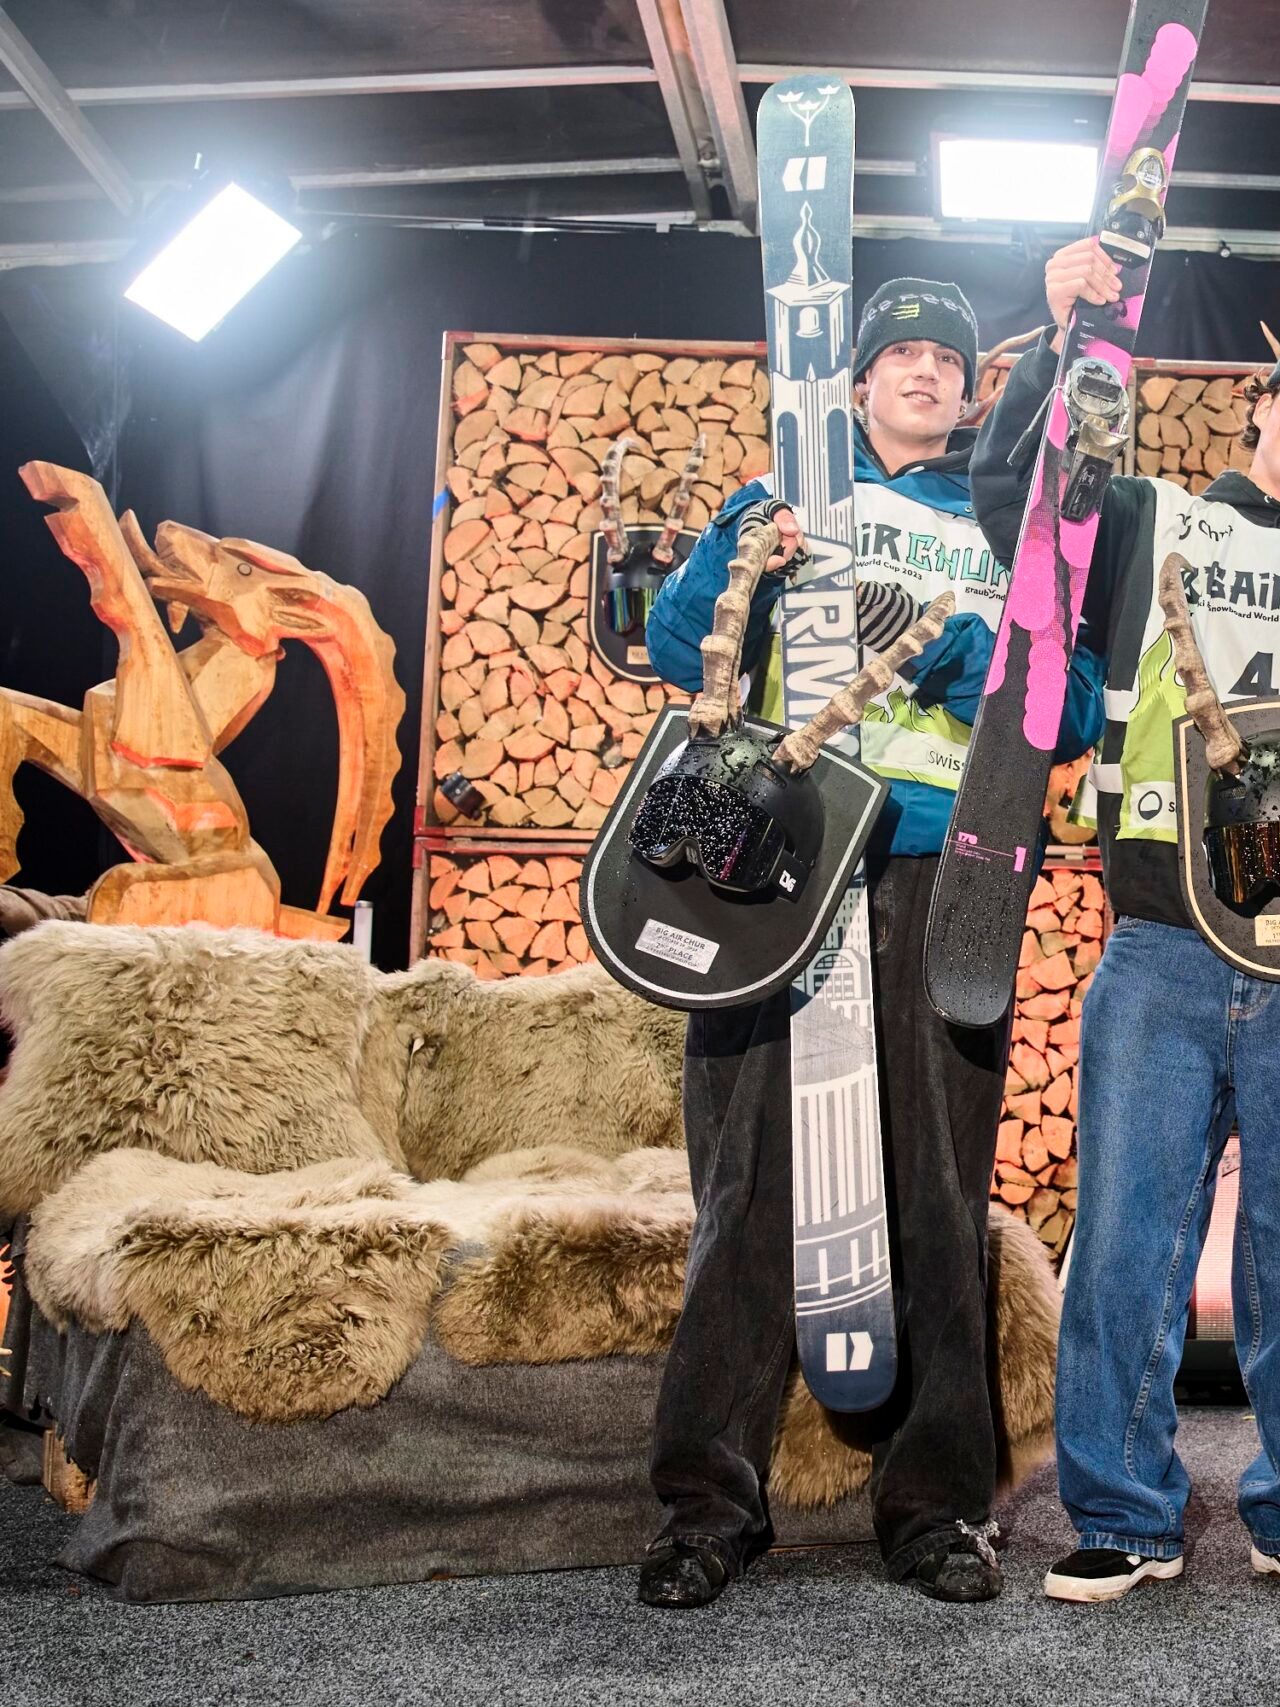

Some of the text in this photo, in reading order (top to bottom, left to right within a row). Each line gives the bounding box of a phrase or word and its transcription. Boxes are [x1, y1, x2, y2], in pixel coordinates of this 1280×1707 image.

[856, 559, 923, 580] World Cup 2023
[1253, 612, 1280, 623] World
[655, 927, 669, 936] BIG
[669, 932, 683, 941] AIR
[683, 937, 706, 949] CHUR
